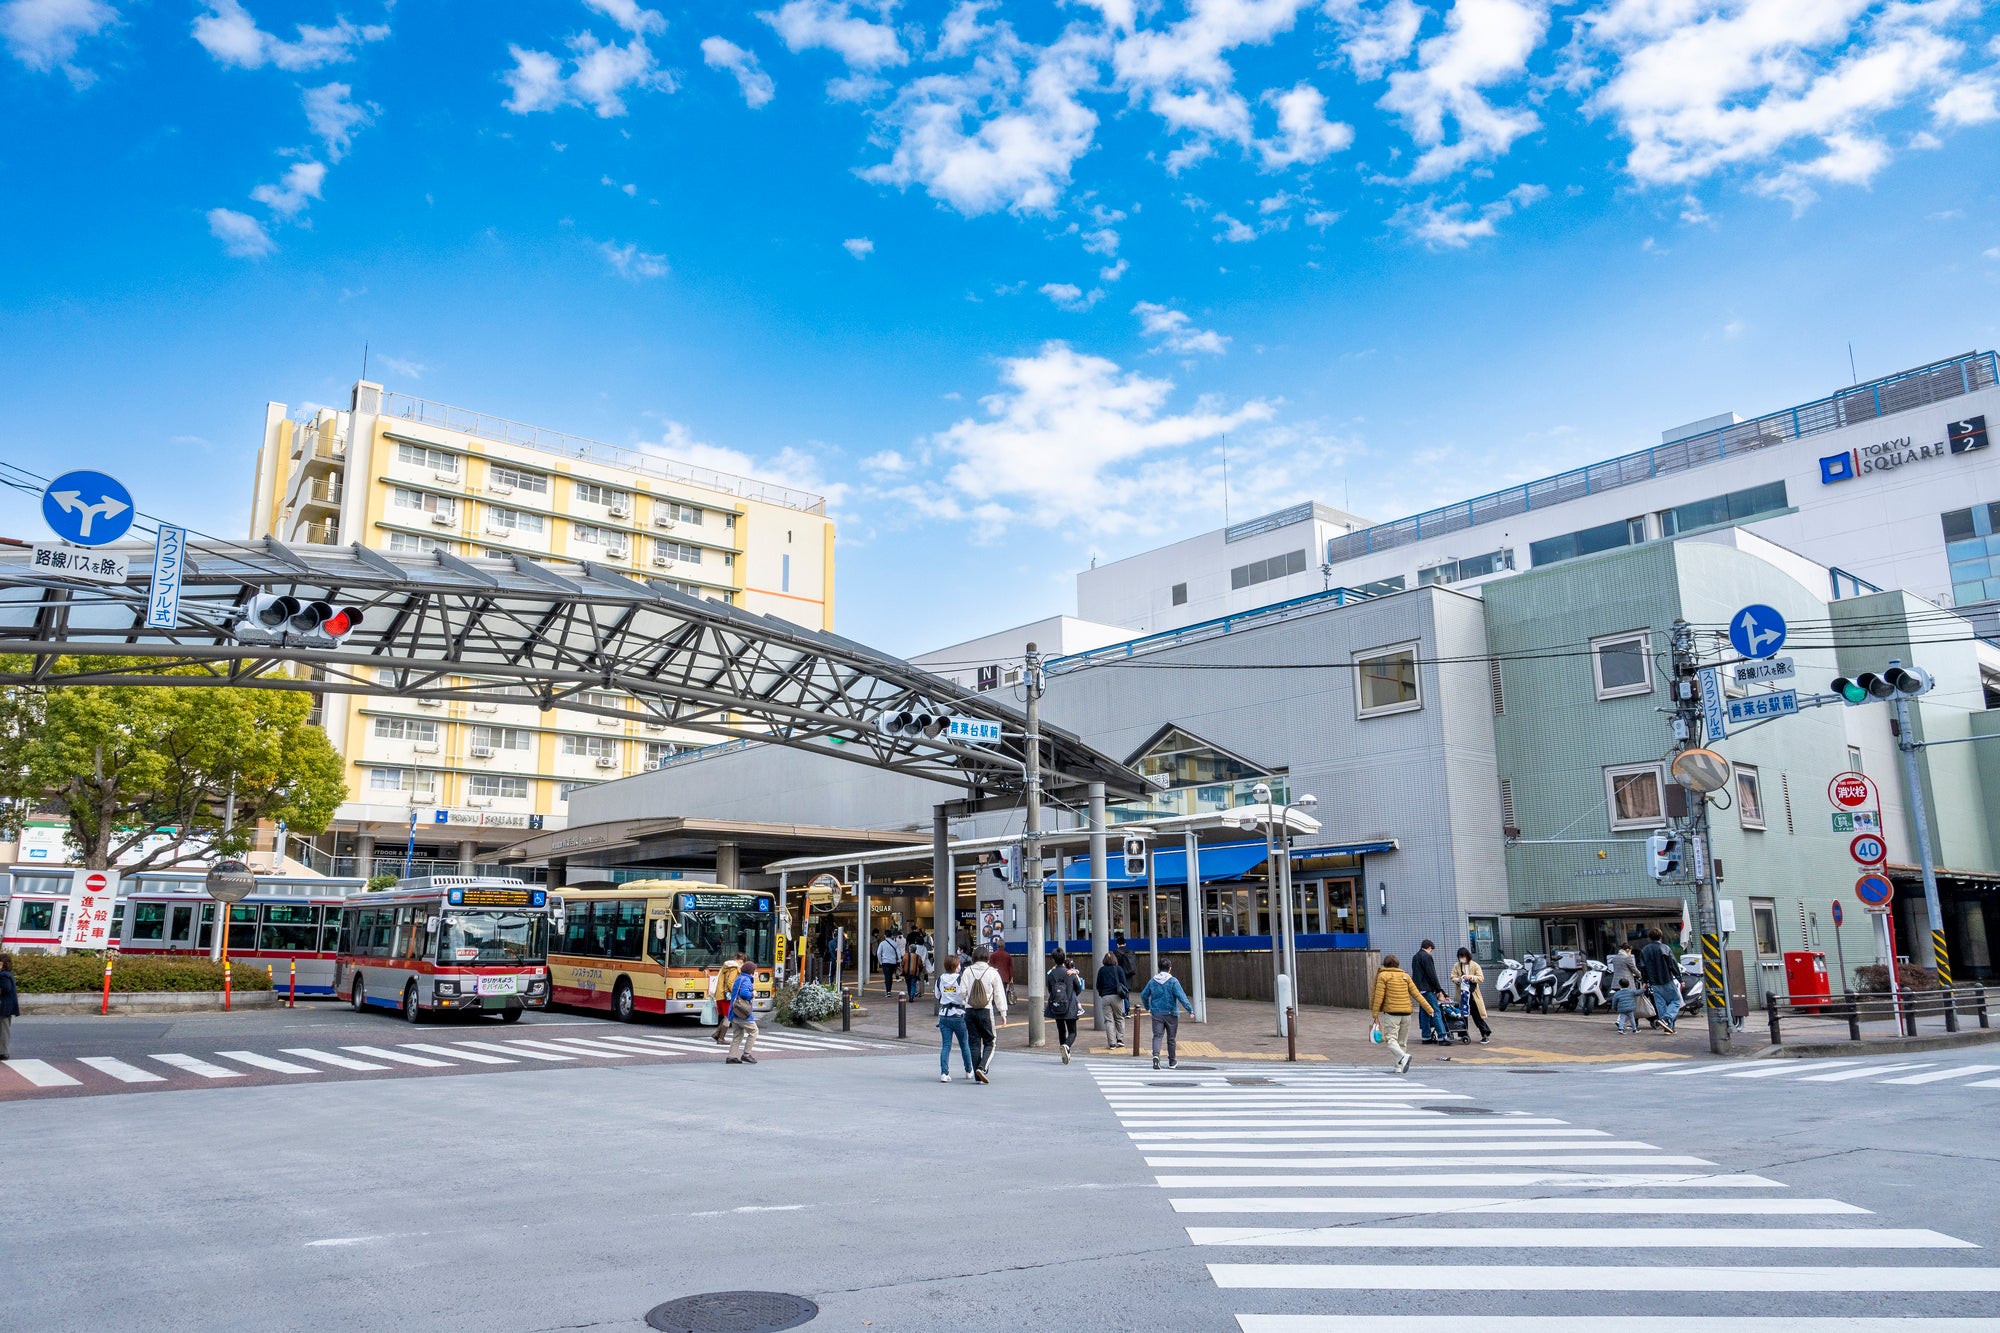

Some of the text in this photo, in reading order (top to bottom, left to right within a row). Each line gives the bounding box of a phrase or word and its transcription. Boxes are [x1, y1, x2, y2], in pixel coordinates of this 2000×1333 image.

[1959, 420, 1973, 434] S
[1861, 436, 1911, 456] TOKYU
[1963, 437, 1976, 452] 2
[1863, 441, 1945, 474] SQUARE
[35, 549, 124, 578] 路線バスを除く
[155, 530, 177, 623] スクランブル式
[983, 667, 992, 680] N
[1737, 662, 1793, 681] 路線バスを除く
[1703, 671, 1721, 737] スクランブル式
[1731, 695, 1794, 718] 青葉台駅前
[950, 721, 998, 739] 青葉台駅前
[1837, 785, 1866, 799] 消火栓
[450, 813, 525, 826] TOKYU SQUARE
[1858, 842, 1879, 857] 40
[74, 896, 94, 942] 進入禁止
[91, 897, 110, 938] 一般車
[571, 967, 603, 979] ノンステップバス
